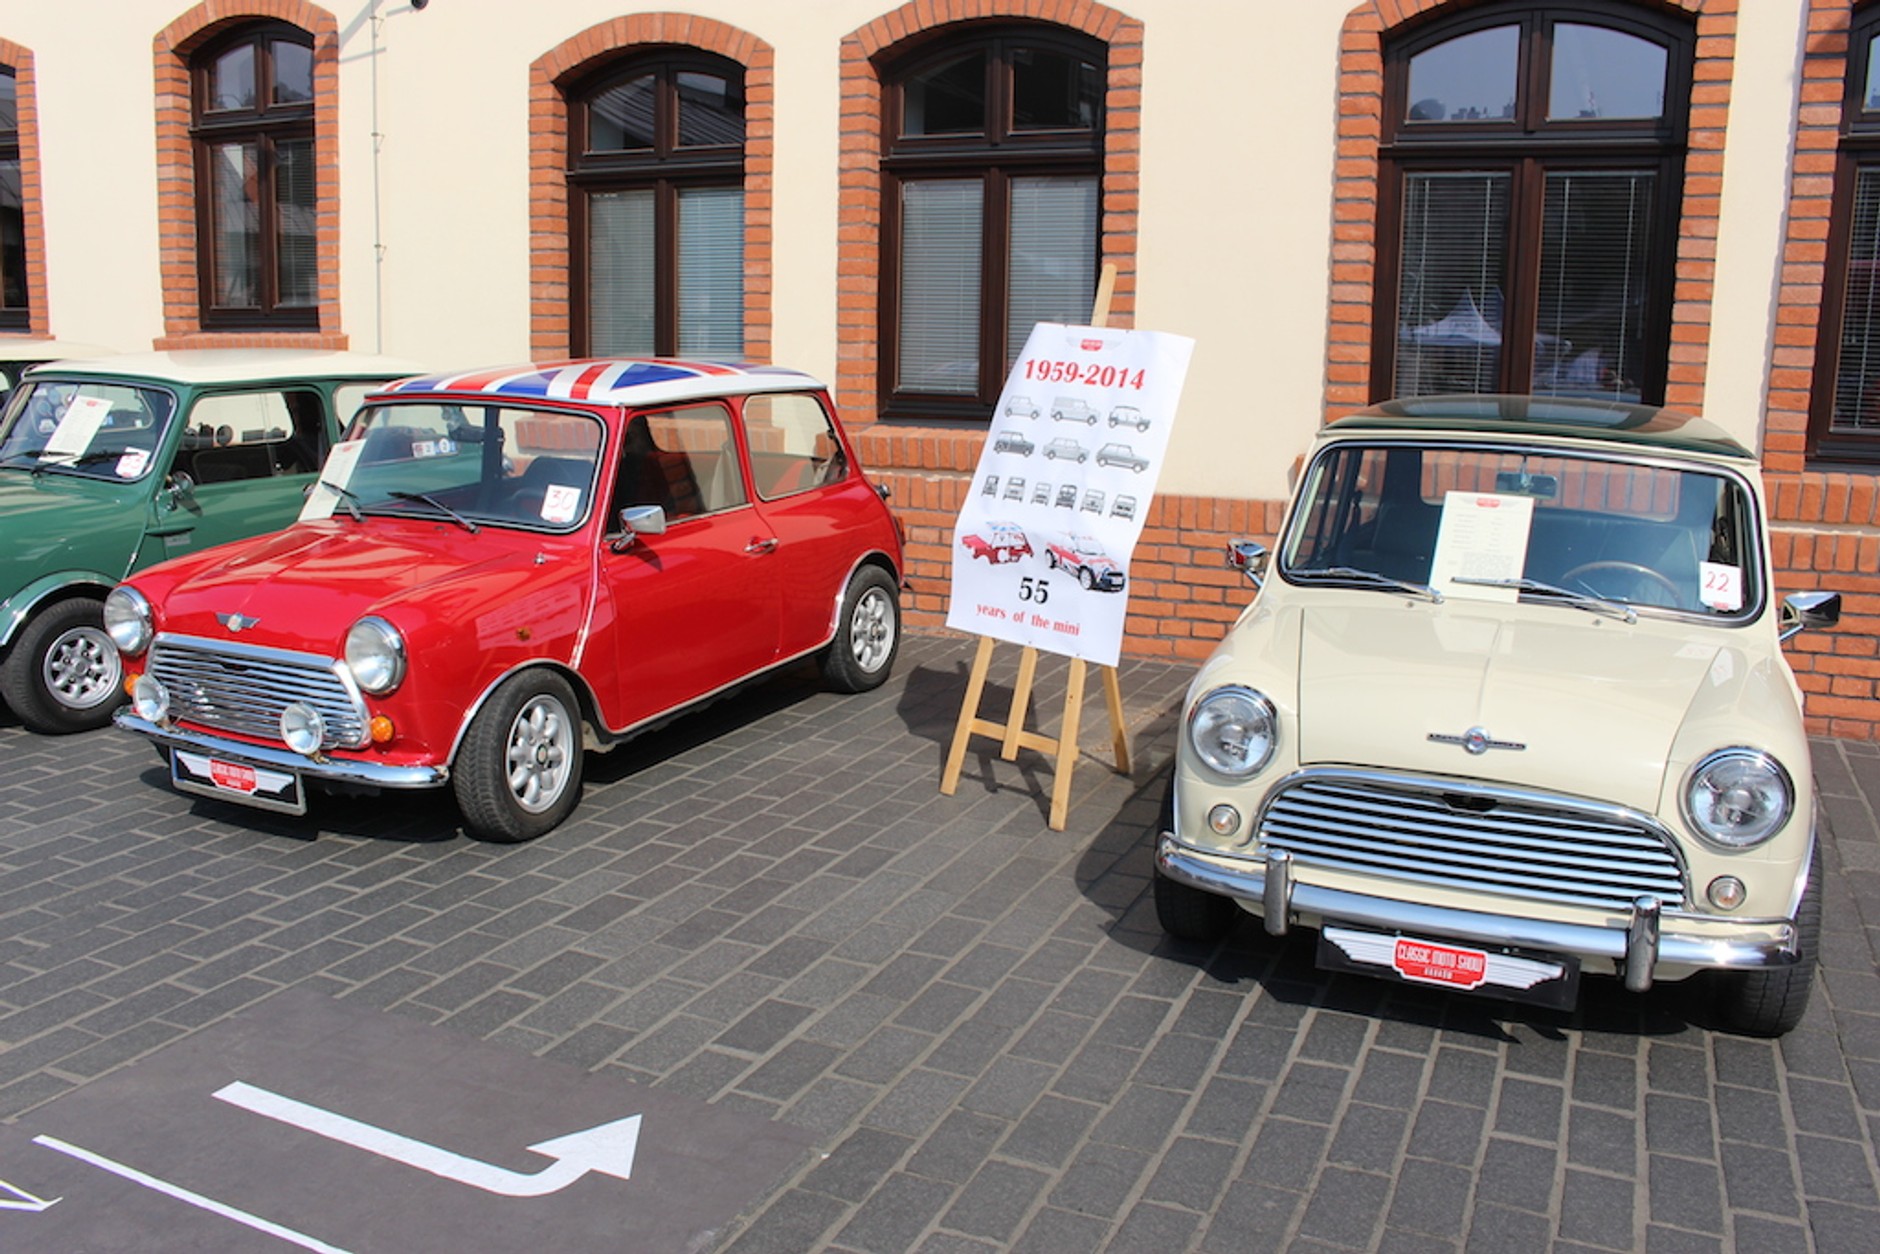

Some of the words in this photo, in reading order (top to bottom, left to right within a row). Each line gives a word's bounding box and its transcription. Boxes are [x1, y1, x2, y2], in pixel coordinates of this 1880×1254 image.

[1025, 359, 1146, 390] 1959-2014
[547, 489, 575, 511] 30
[1018, 576, 1049, 604] 55
[1705, 570, 1729, 592] 22
[976, 603, 1007, 620] years
[1012, 611, 1026, 624] of
[1031, 613, 1050, 629] the
[1053, 621, 1080, 636] mini
[1397, 943, 1431, 963] CLASSIC
